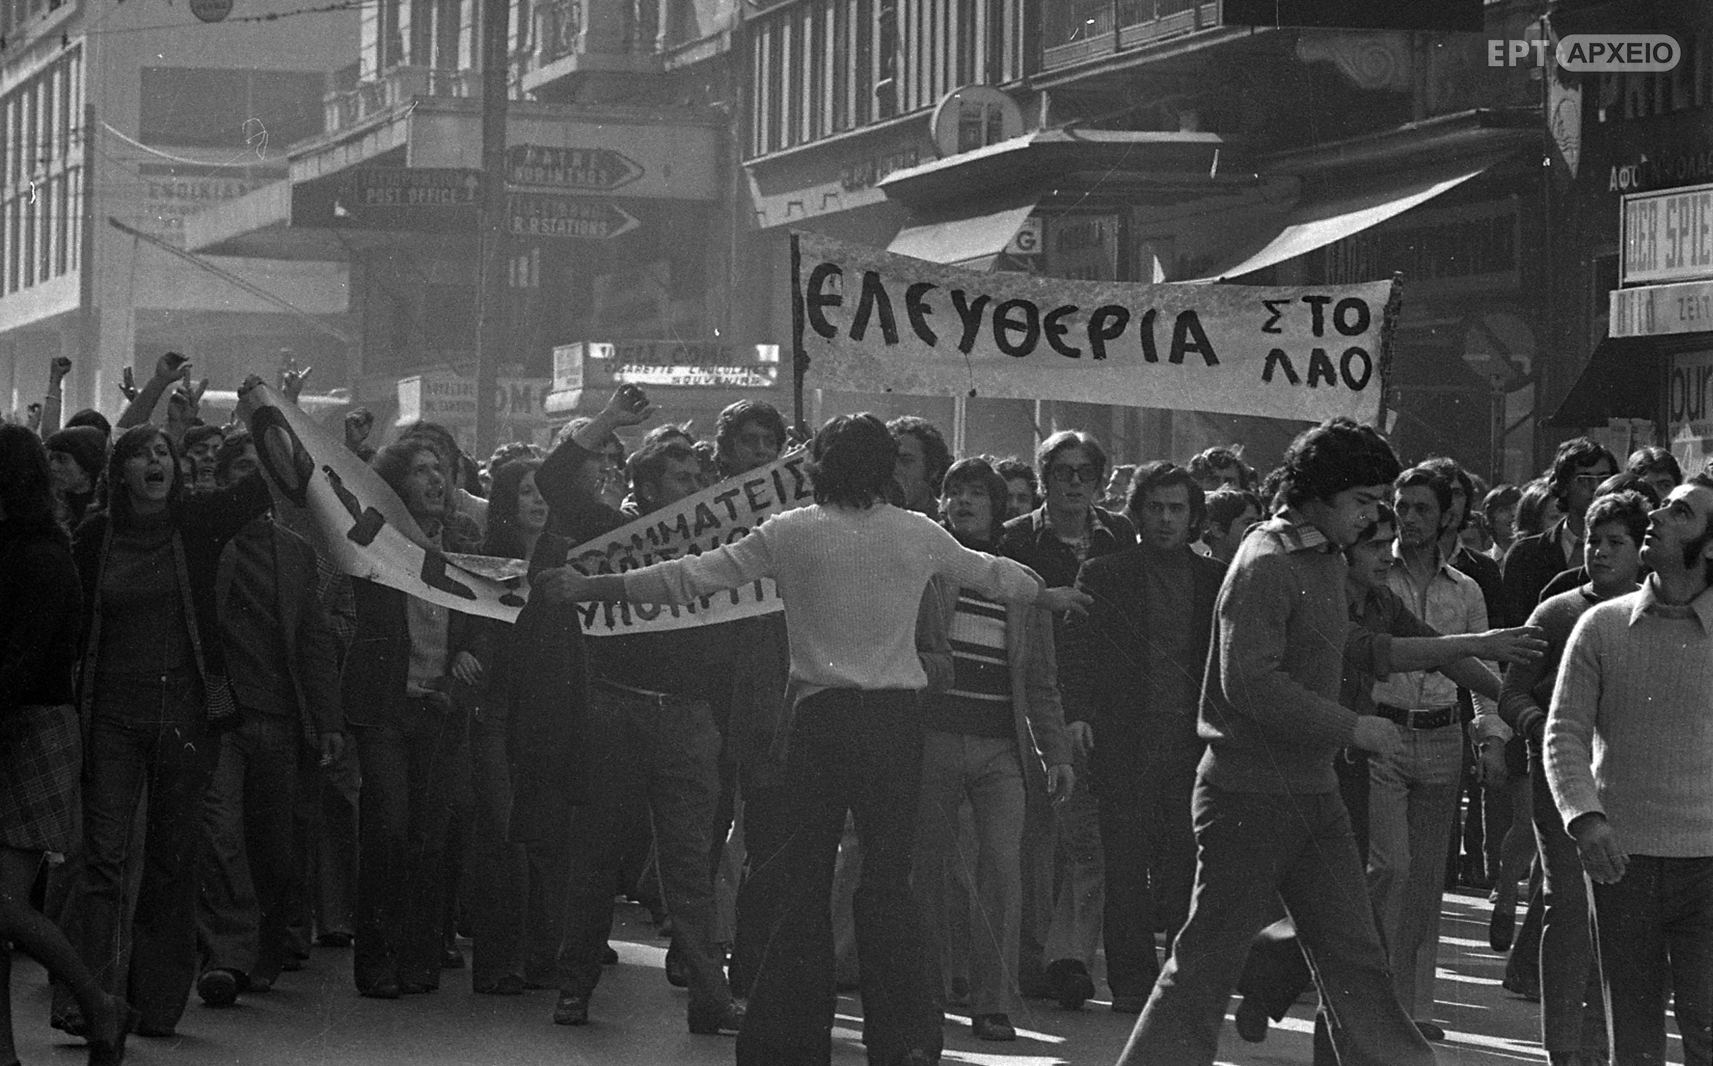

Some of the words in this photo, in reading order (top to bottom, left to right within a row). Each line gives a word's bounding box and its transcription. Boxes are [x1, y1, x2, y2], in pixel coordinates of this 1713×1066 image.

[366, 188, 402, 205] POST
[407, 188, 458, 206] OFFICE
[1627, 200, 1657, 272] DER
[807, 262, 1220, 366] ΕΛΕΥΘΕΡΙΑ
[1262, 296, 1370, 337] ΣΤΟ
[1261, 347, 1373, 391] ΛΑΟ
